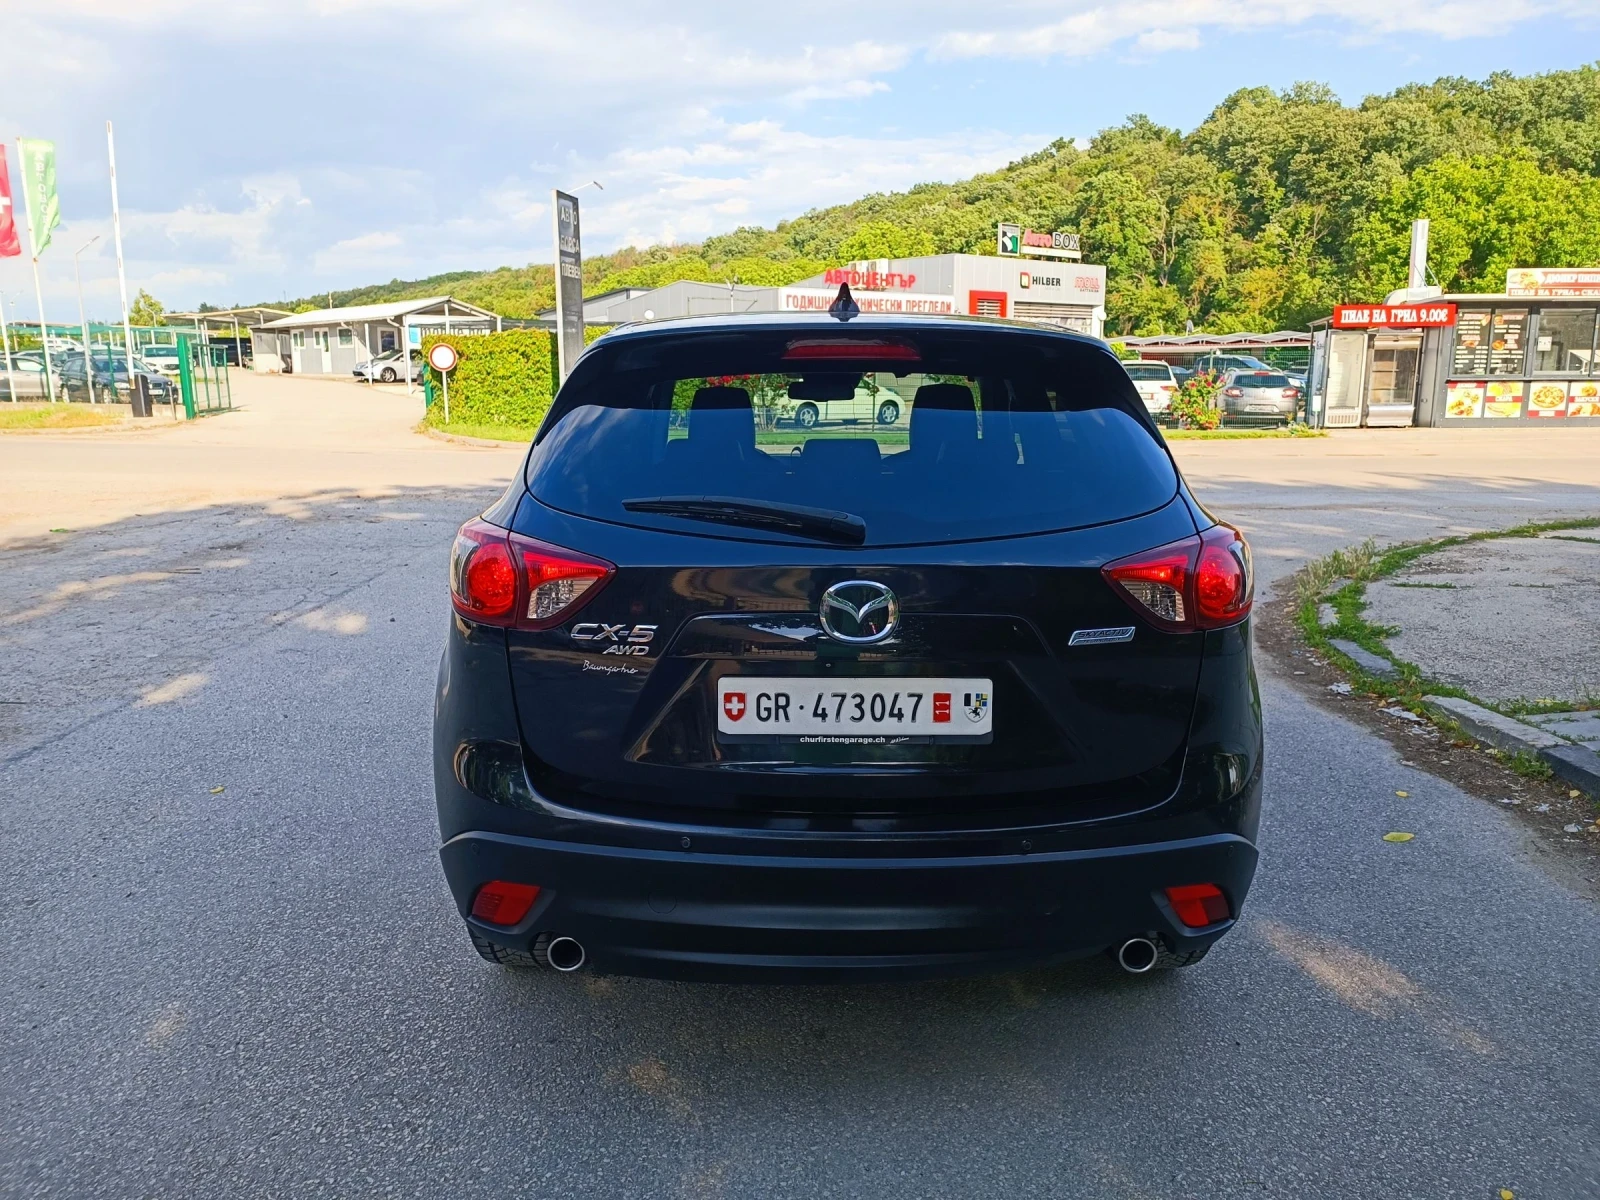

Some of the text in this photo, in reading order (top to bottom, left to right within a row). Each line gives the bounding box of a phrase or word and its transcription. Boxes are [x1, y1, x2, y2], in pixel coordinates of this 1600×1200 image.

[824, 269, 916, 289] АВТОЦЕНТЪР
[1032, 276, 1061, 287] HILBER
[905, 299, 952, 314] ПРЕГЛЕДИ
[1340, 309, 1370, 324] ПИЛЕ
[1372, 309, 1387, 323] НА
[1390, 308, 1418, 323] ГРИЛ
[1420, 308, 1448, 323] 9.00€
[570, 623, 659, 643] CX-5
[1078, 629, 1129, 638] SKYACTIV
[602, 644, 650, 656] AWD
[756, 692, 791, 723] GR
[812, 692, 924, 723] 473047
[799, 736, 886, 745] churfirstengarage.ch
